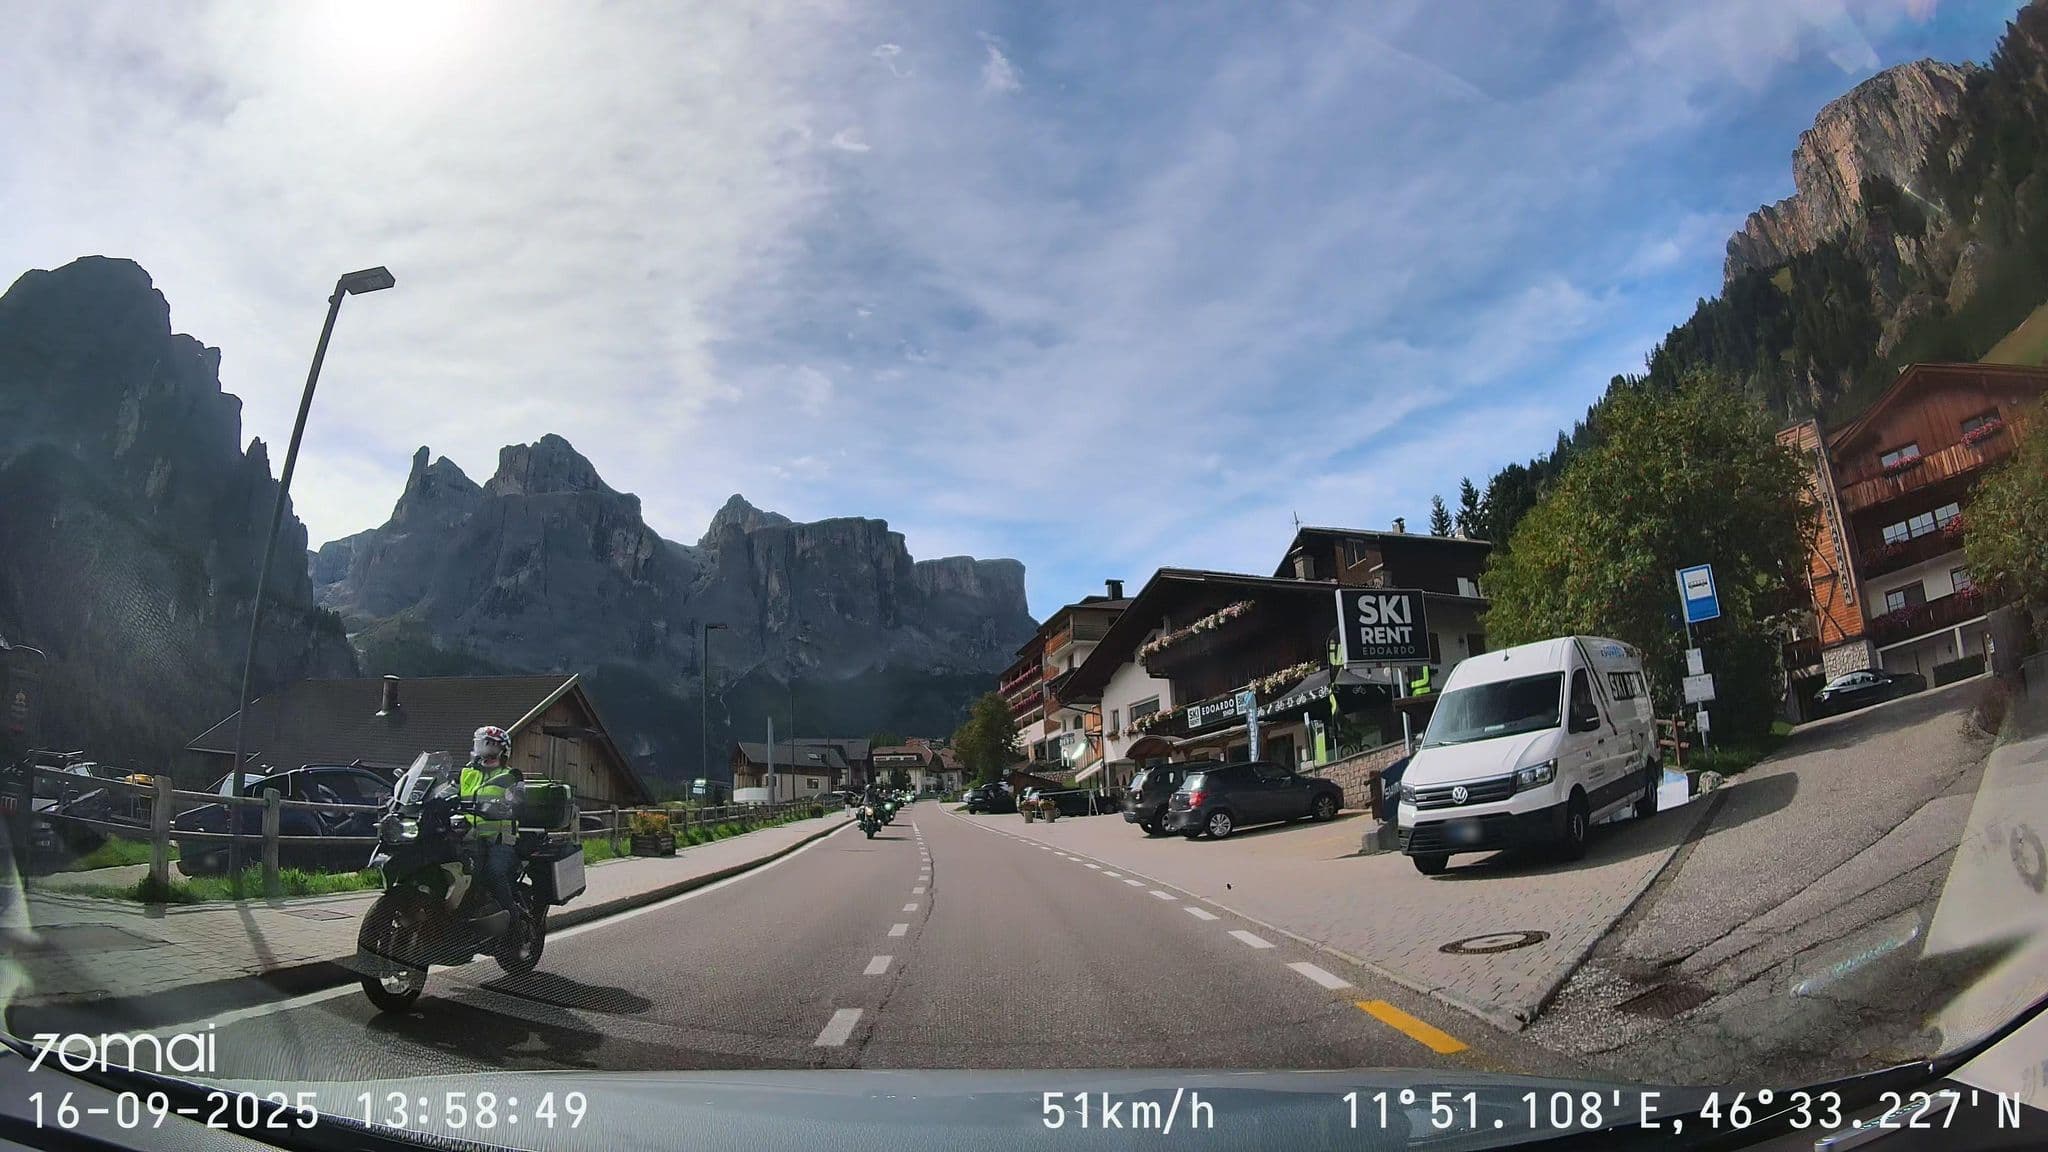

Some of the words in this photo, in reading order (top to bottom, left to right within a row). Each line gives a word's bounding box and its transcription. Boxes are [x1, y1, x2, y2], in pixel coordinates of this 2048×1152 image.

[1357, 594, 1413, 625] SKI
[1360, 626, 1413, 644] RENT
[1362, 645, 1416, 656] EDOARDO
[1188, 707, 1200, 720] SKI
[1201, 698, 1235, 716] EDOARDO
